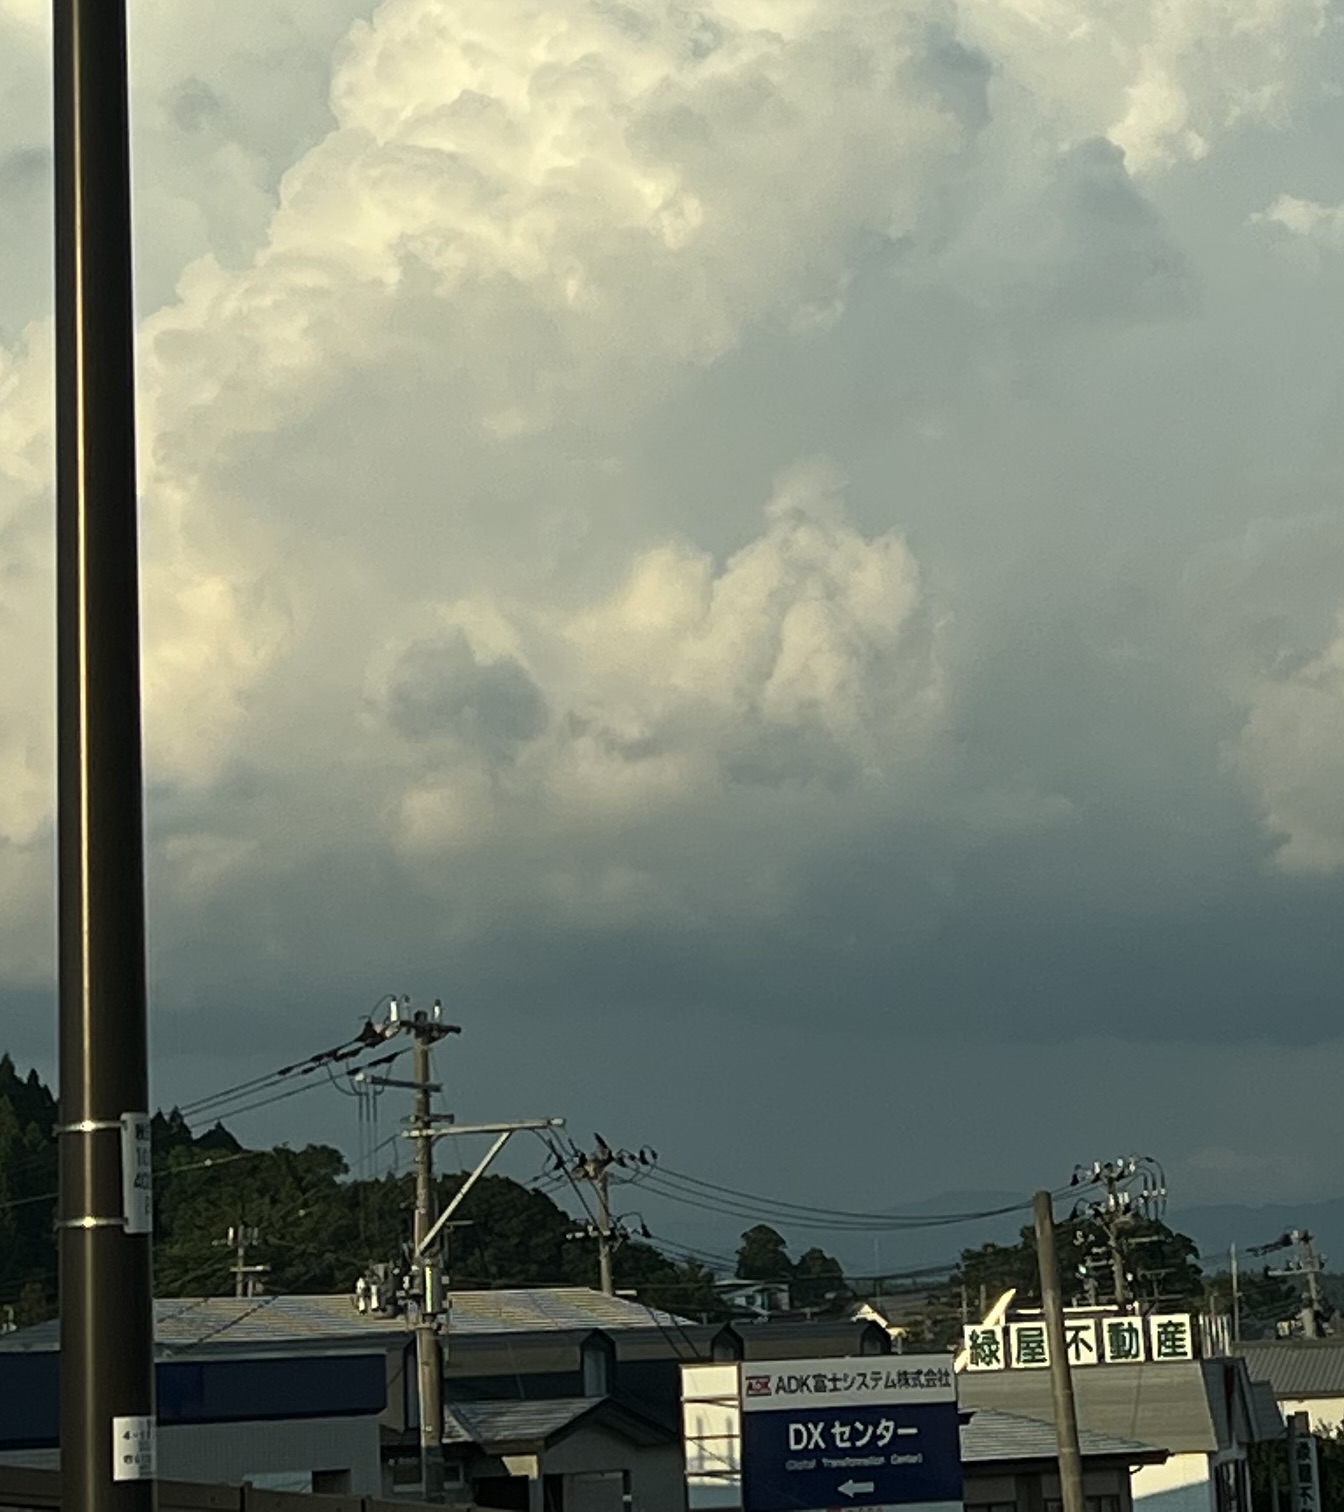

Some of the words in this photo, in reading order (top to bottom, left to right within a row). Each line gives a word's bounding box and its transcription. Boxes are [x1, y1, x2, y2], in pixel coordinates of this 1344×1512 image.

[969, 1320, 1189, 1366] 緑屋不動産
[775, 1369, 952, 1395] ADK富士システム株式会社
